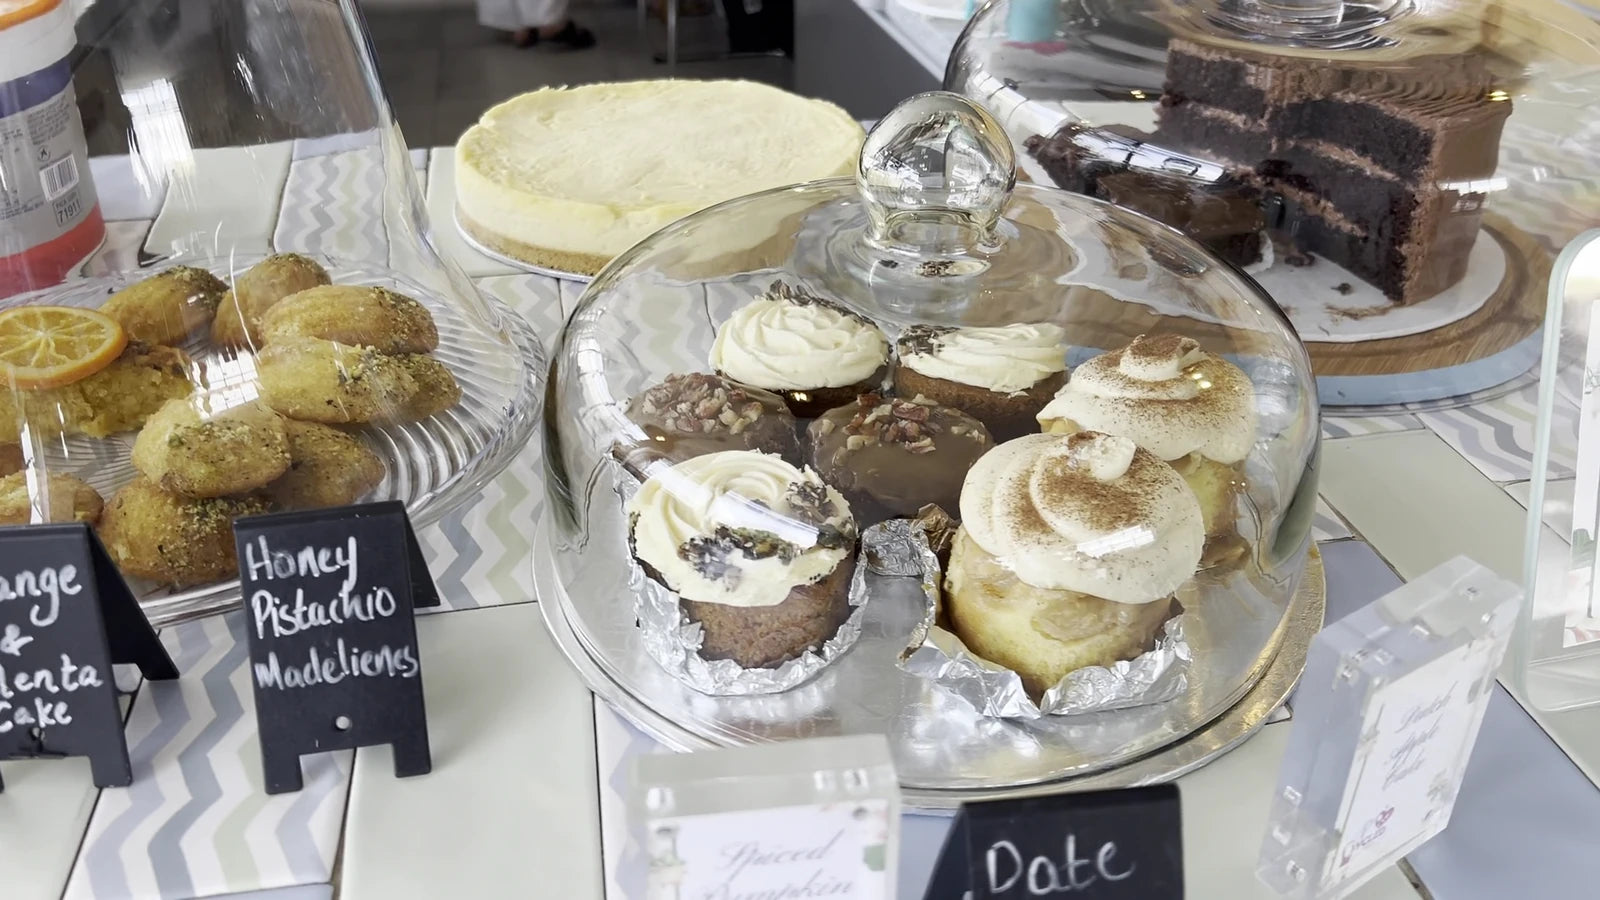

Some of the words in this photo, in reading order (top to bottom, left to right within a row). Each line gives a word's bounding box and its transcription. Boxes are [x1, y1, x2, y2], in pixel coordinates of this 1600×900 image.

[246, 535, 357, 591] Honey
[251, 579, 396, 639] Pistachio
[715, 827, 845, 882] Spiced
[986, 834, 1137, 896] Date
